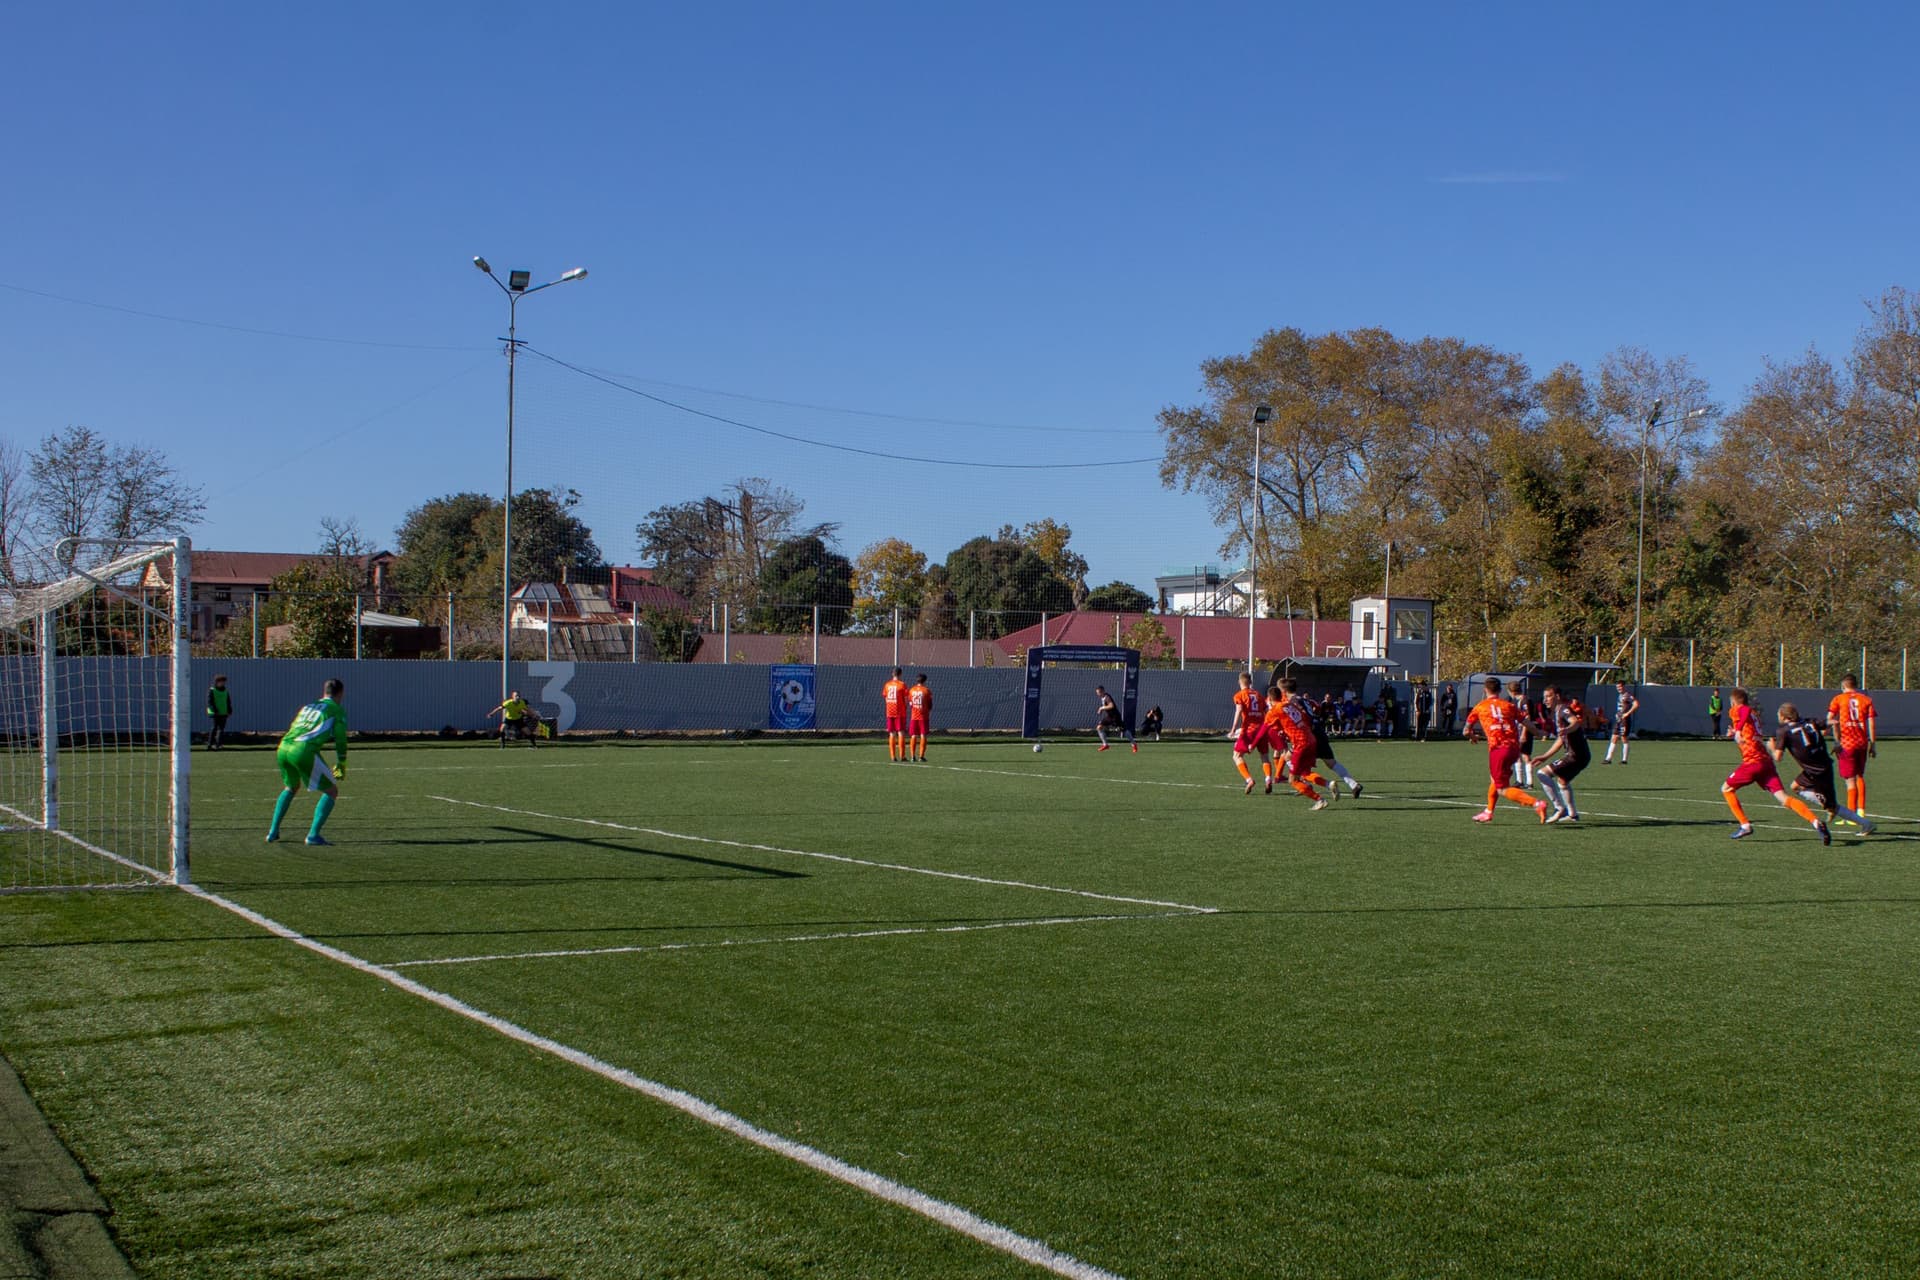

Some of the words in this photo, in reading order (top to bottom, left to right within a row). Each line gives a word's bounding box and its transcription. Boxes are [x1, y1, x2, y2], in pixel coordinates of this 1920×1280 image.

[528, 661, 577, 732] 3
[1490, 703, 1504, 723] 4
[1848, 698, 1860, 721] 6
